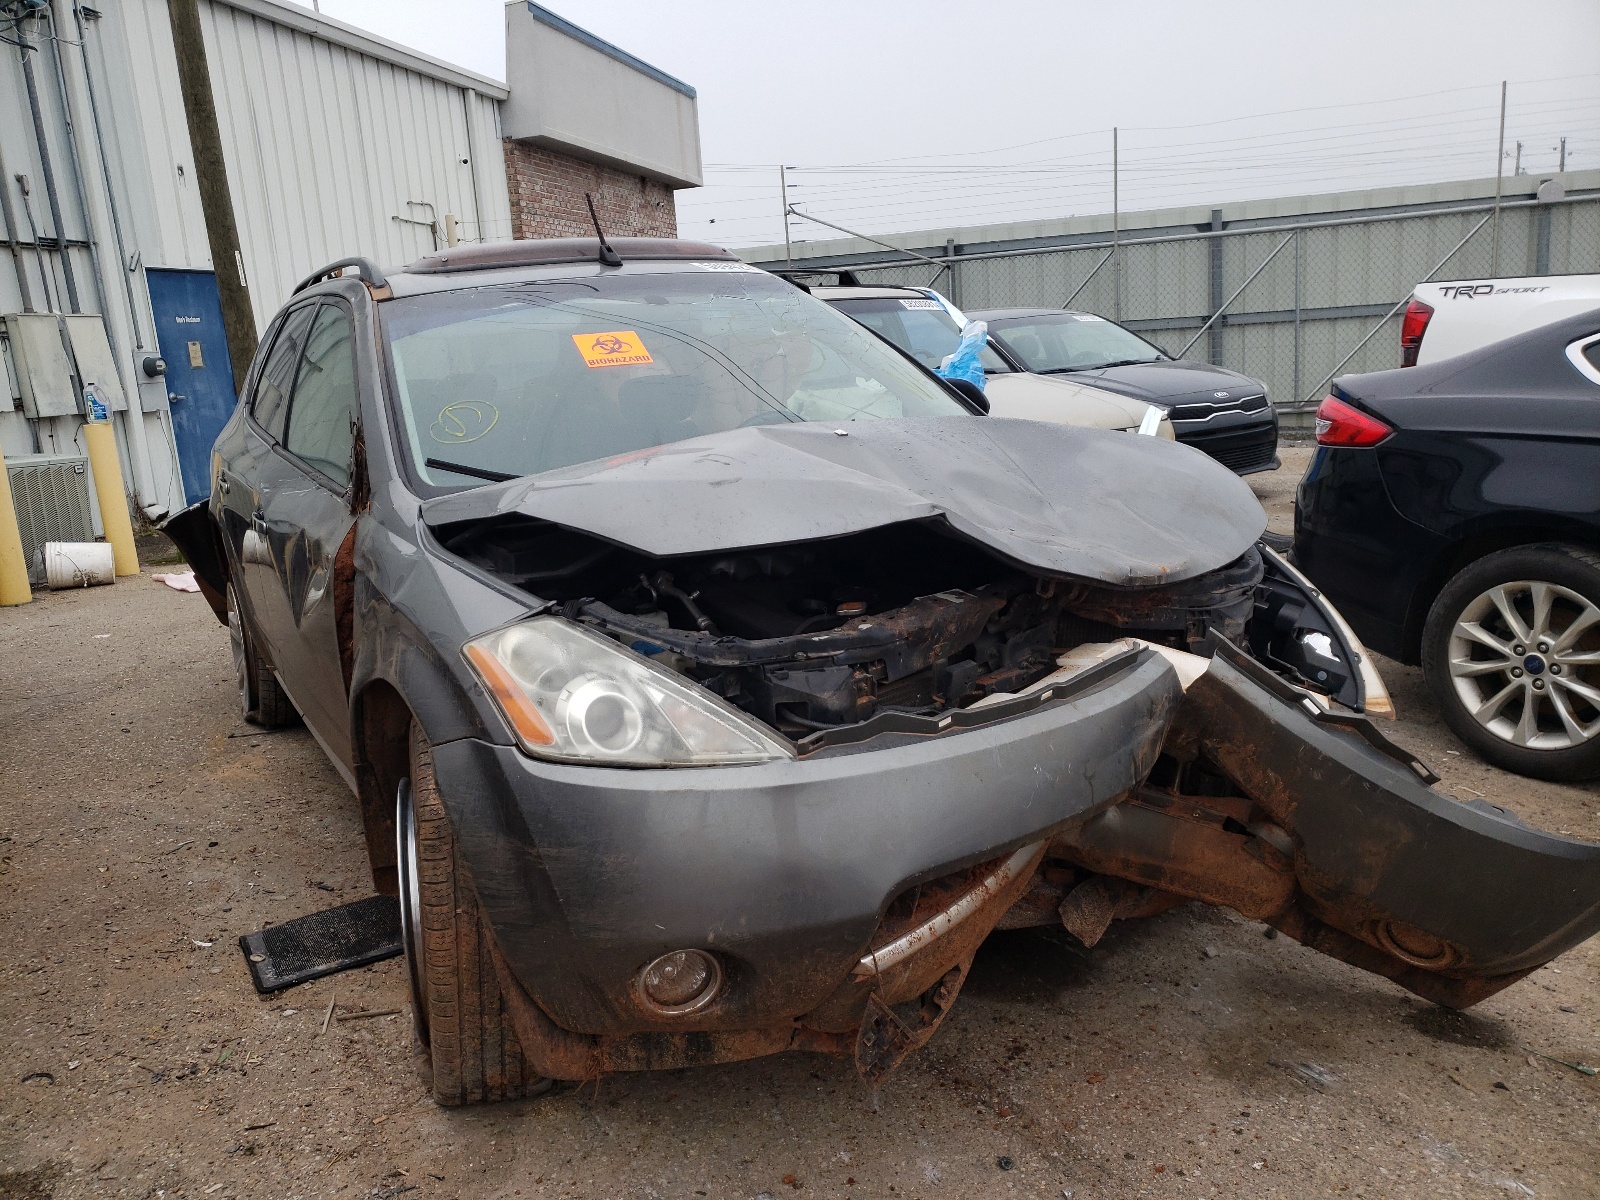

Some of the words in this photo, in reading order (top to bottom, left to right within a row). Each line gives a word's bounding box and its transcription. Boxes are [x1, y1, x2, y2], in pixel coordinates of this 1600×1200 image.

[1439, 284, 1494, 300] TRD
[1494, 286, 1550, 295] SPORT
[588, 355, 650, 366] BIOHAZARD
